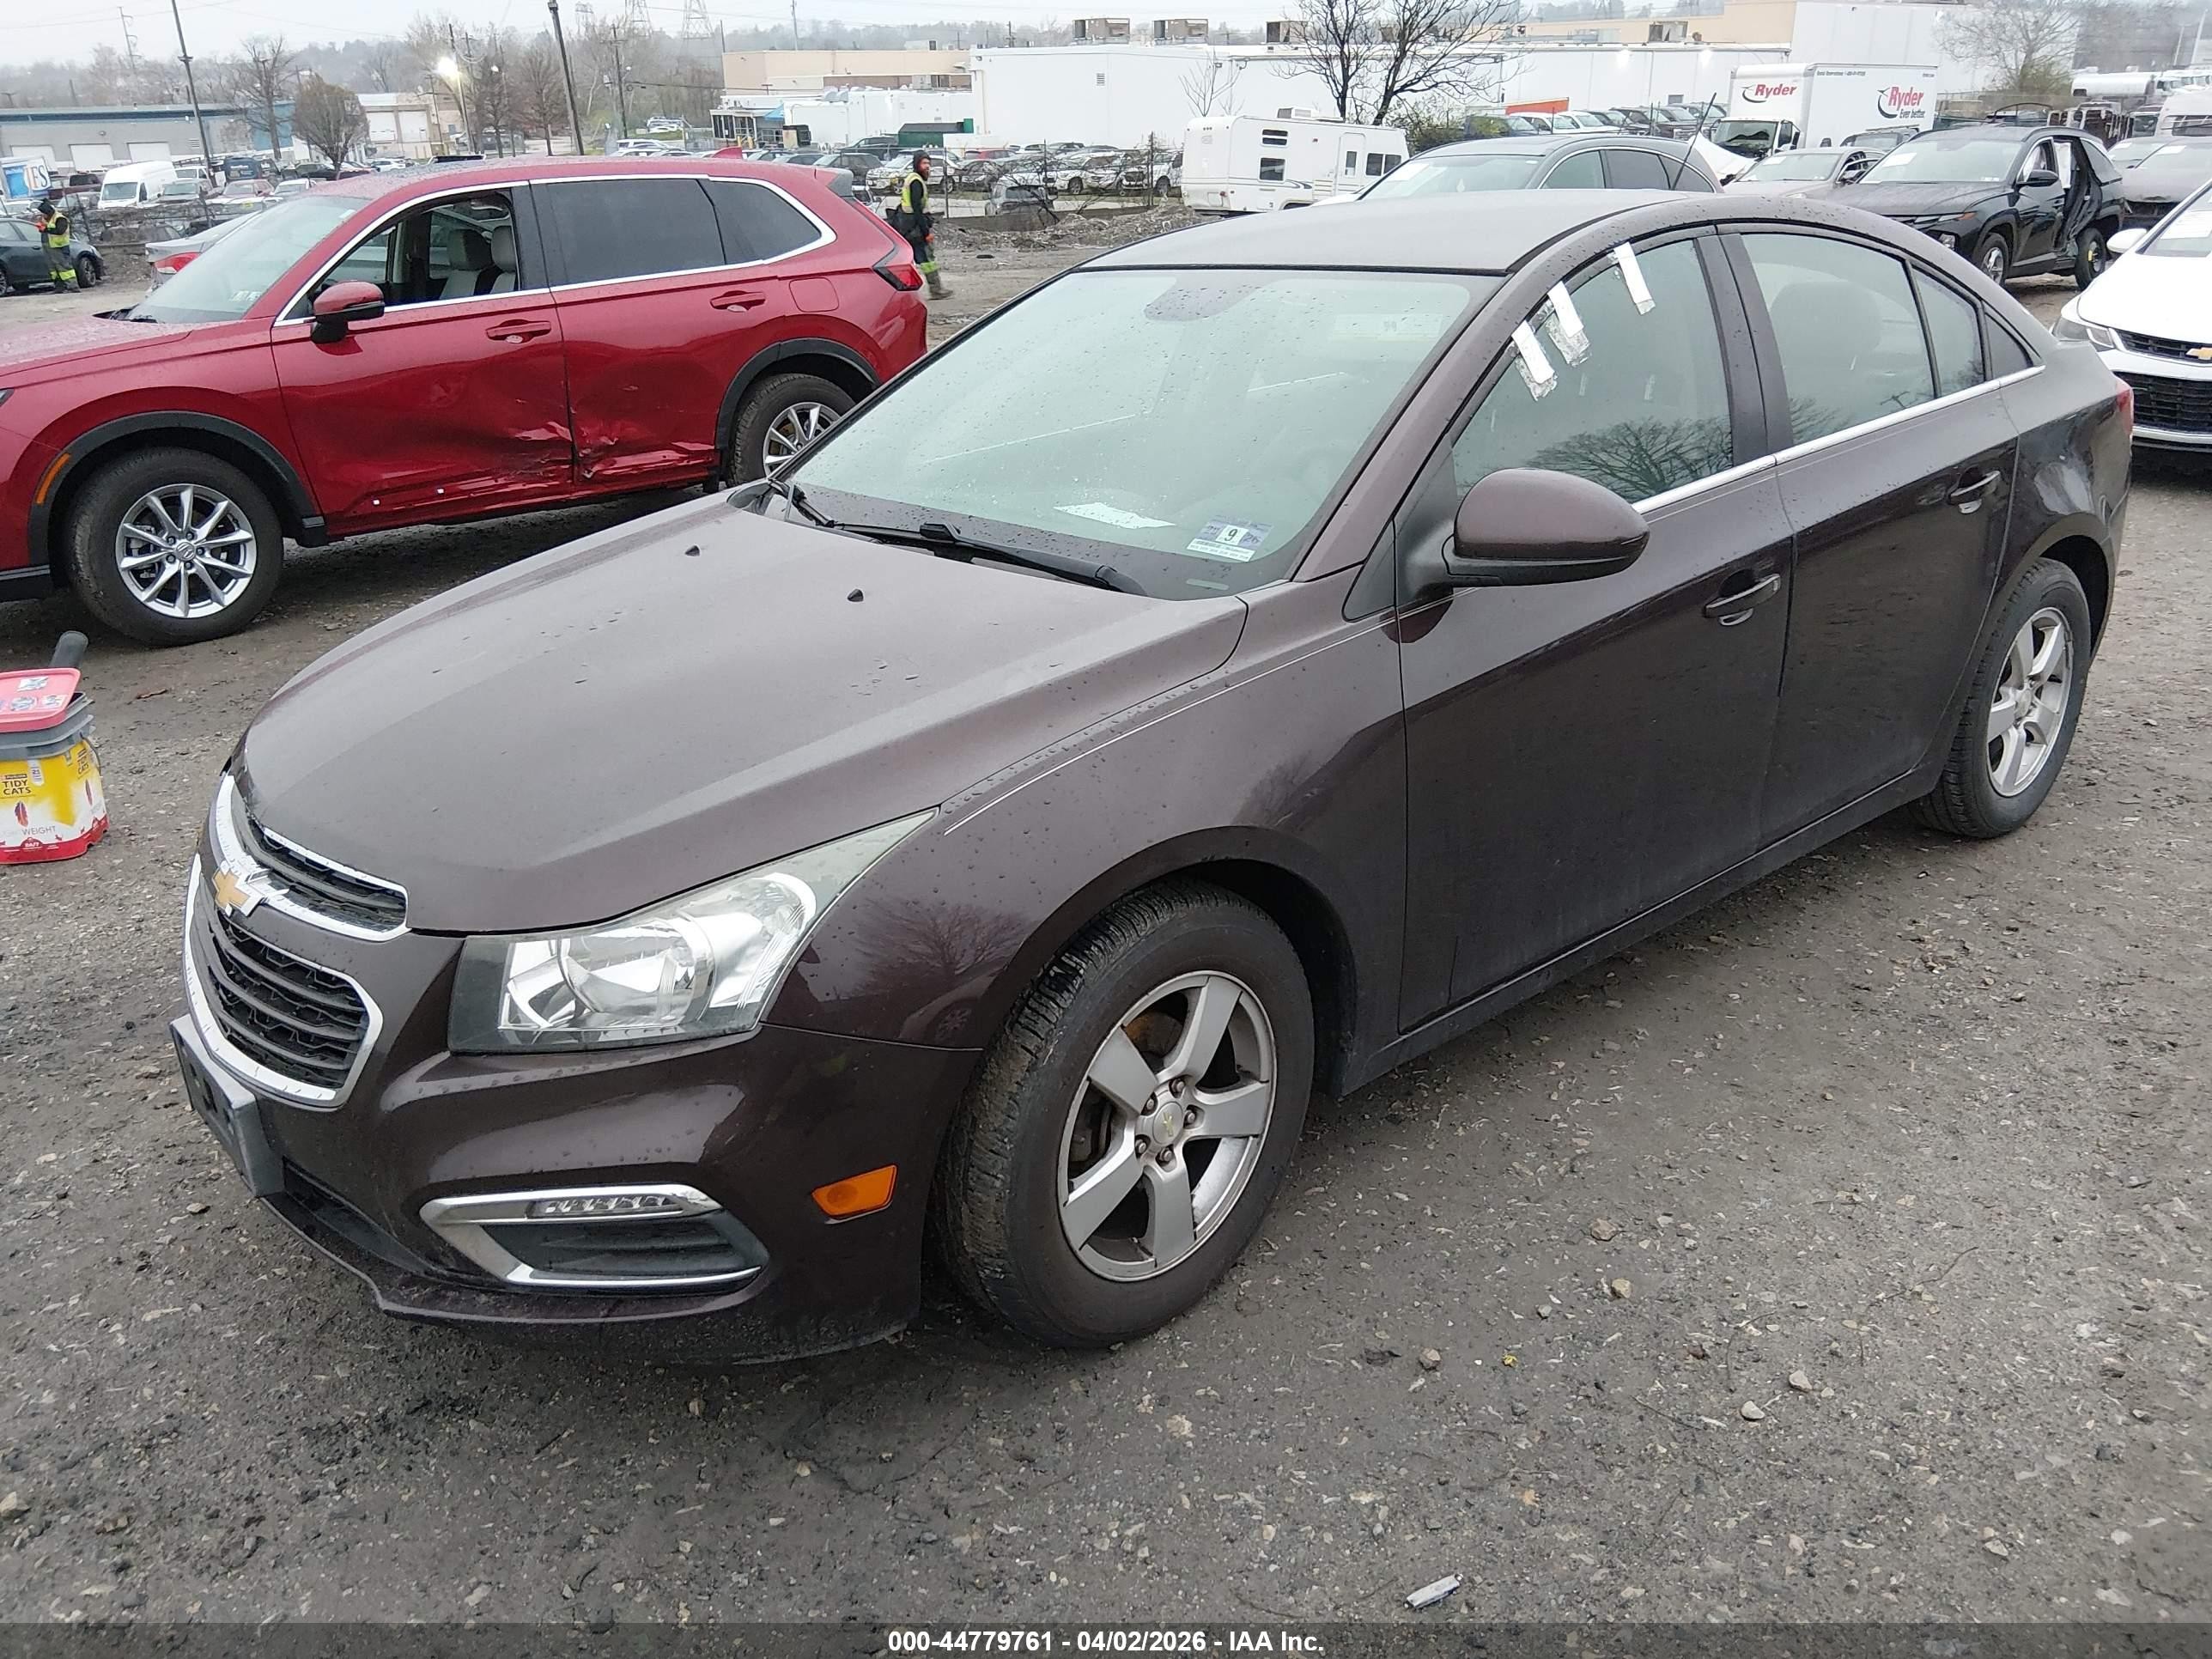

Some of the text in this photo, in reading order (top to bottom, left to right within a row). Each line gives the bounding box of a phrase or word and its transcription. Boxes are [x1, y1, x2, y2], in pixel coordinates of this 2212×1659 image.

[1754, 83, 1797, 99] Ryder
[1888, 86, 1924, 112] Ryder
[1224, 528, 1239, 542] 9
[2, 779, 27, 788] TIDY
[3, 787, 32, 795] CATS
[21, 825, 57, 836] WEIGHT
